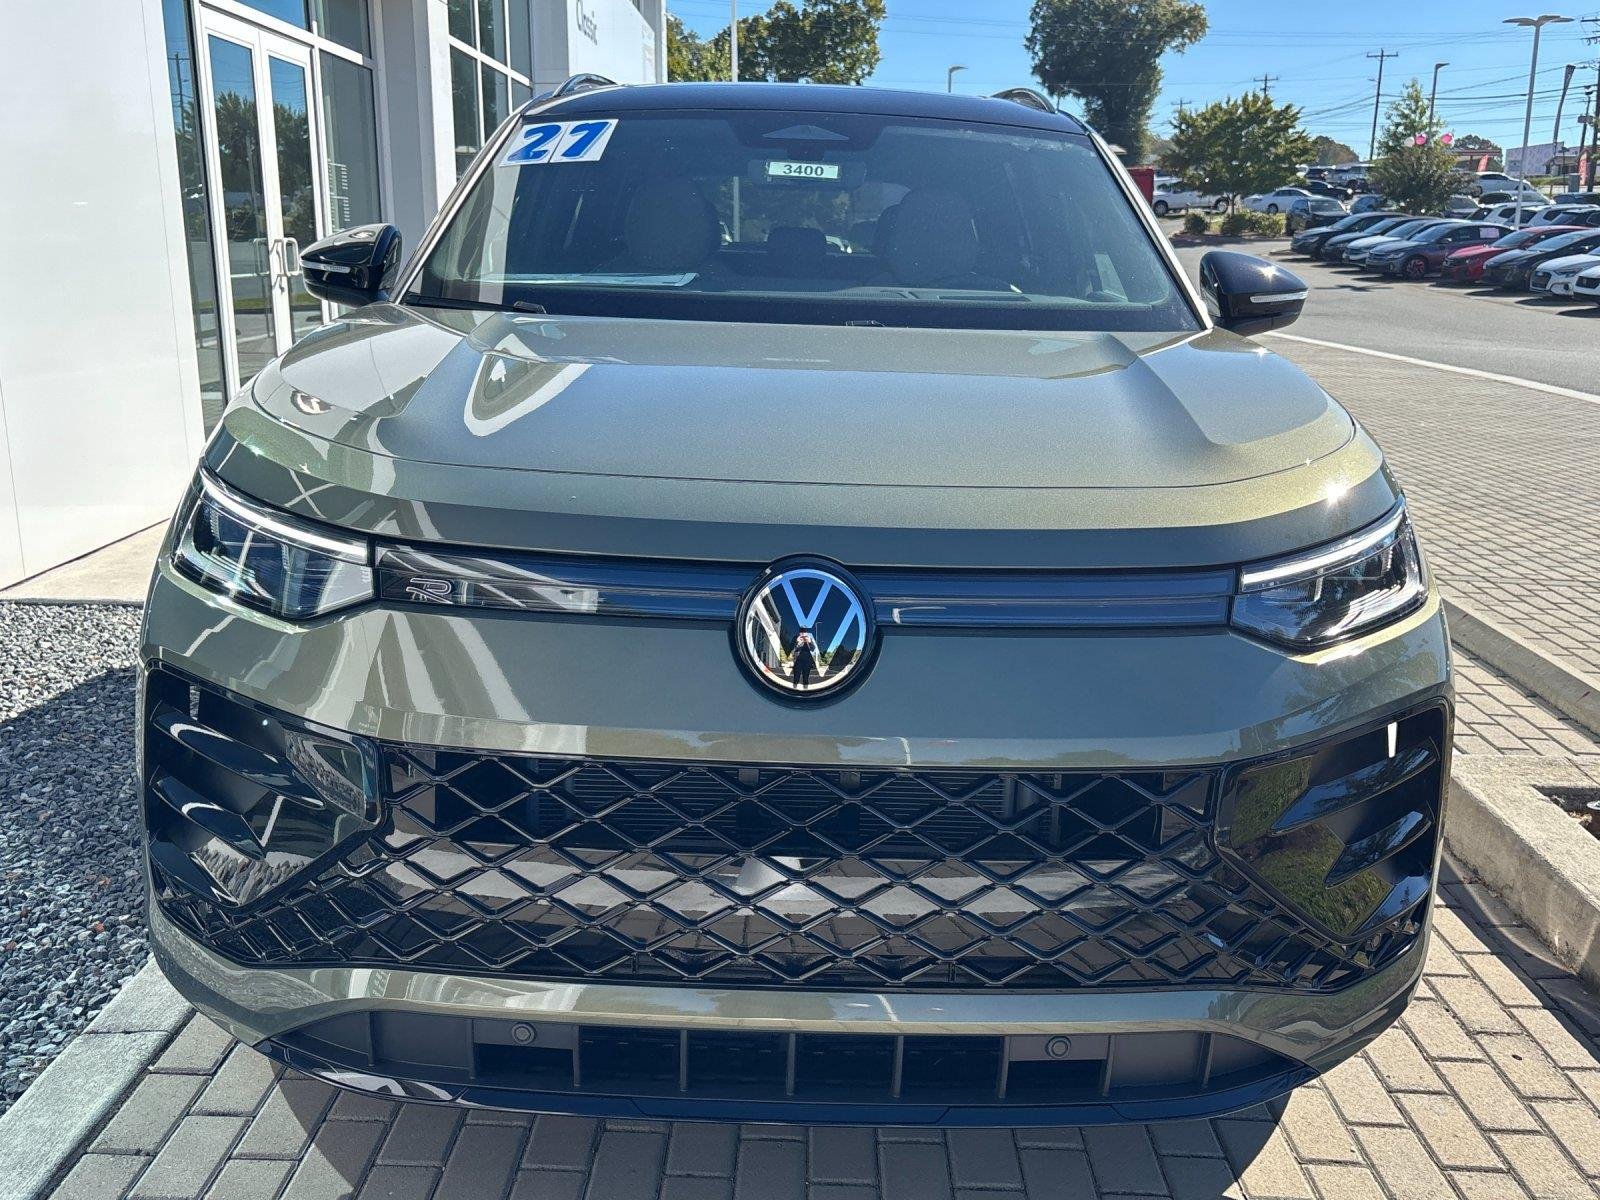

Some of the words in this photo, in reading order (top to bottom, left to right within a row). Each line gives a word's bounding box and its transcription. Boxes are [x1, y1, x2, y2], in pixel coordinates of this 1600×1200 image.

[576, 0, 598, 46] Classic
[506, 121, 612, 162] 27
[782, 164, 825, 176] 3400
